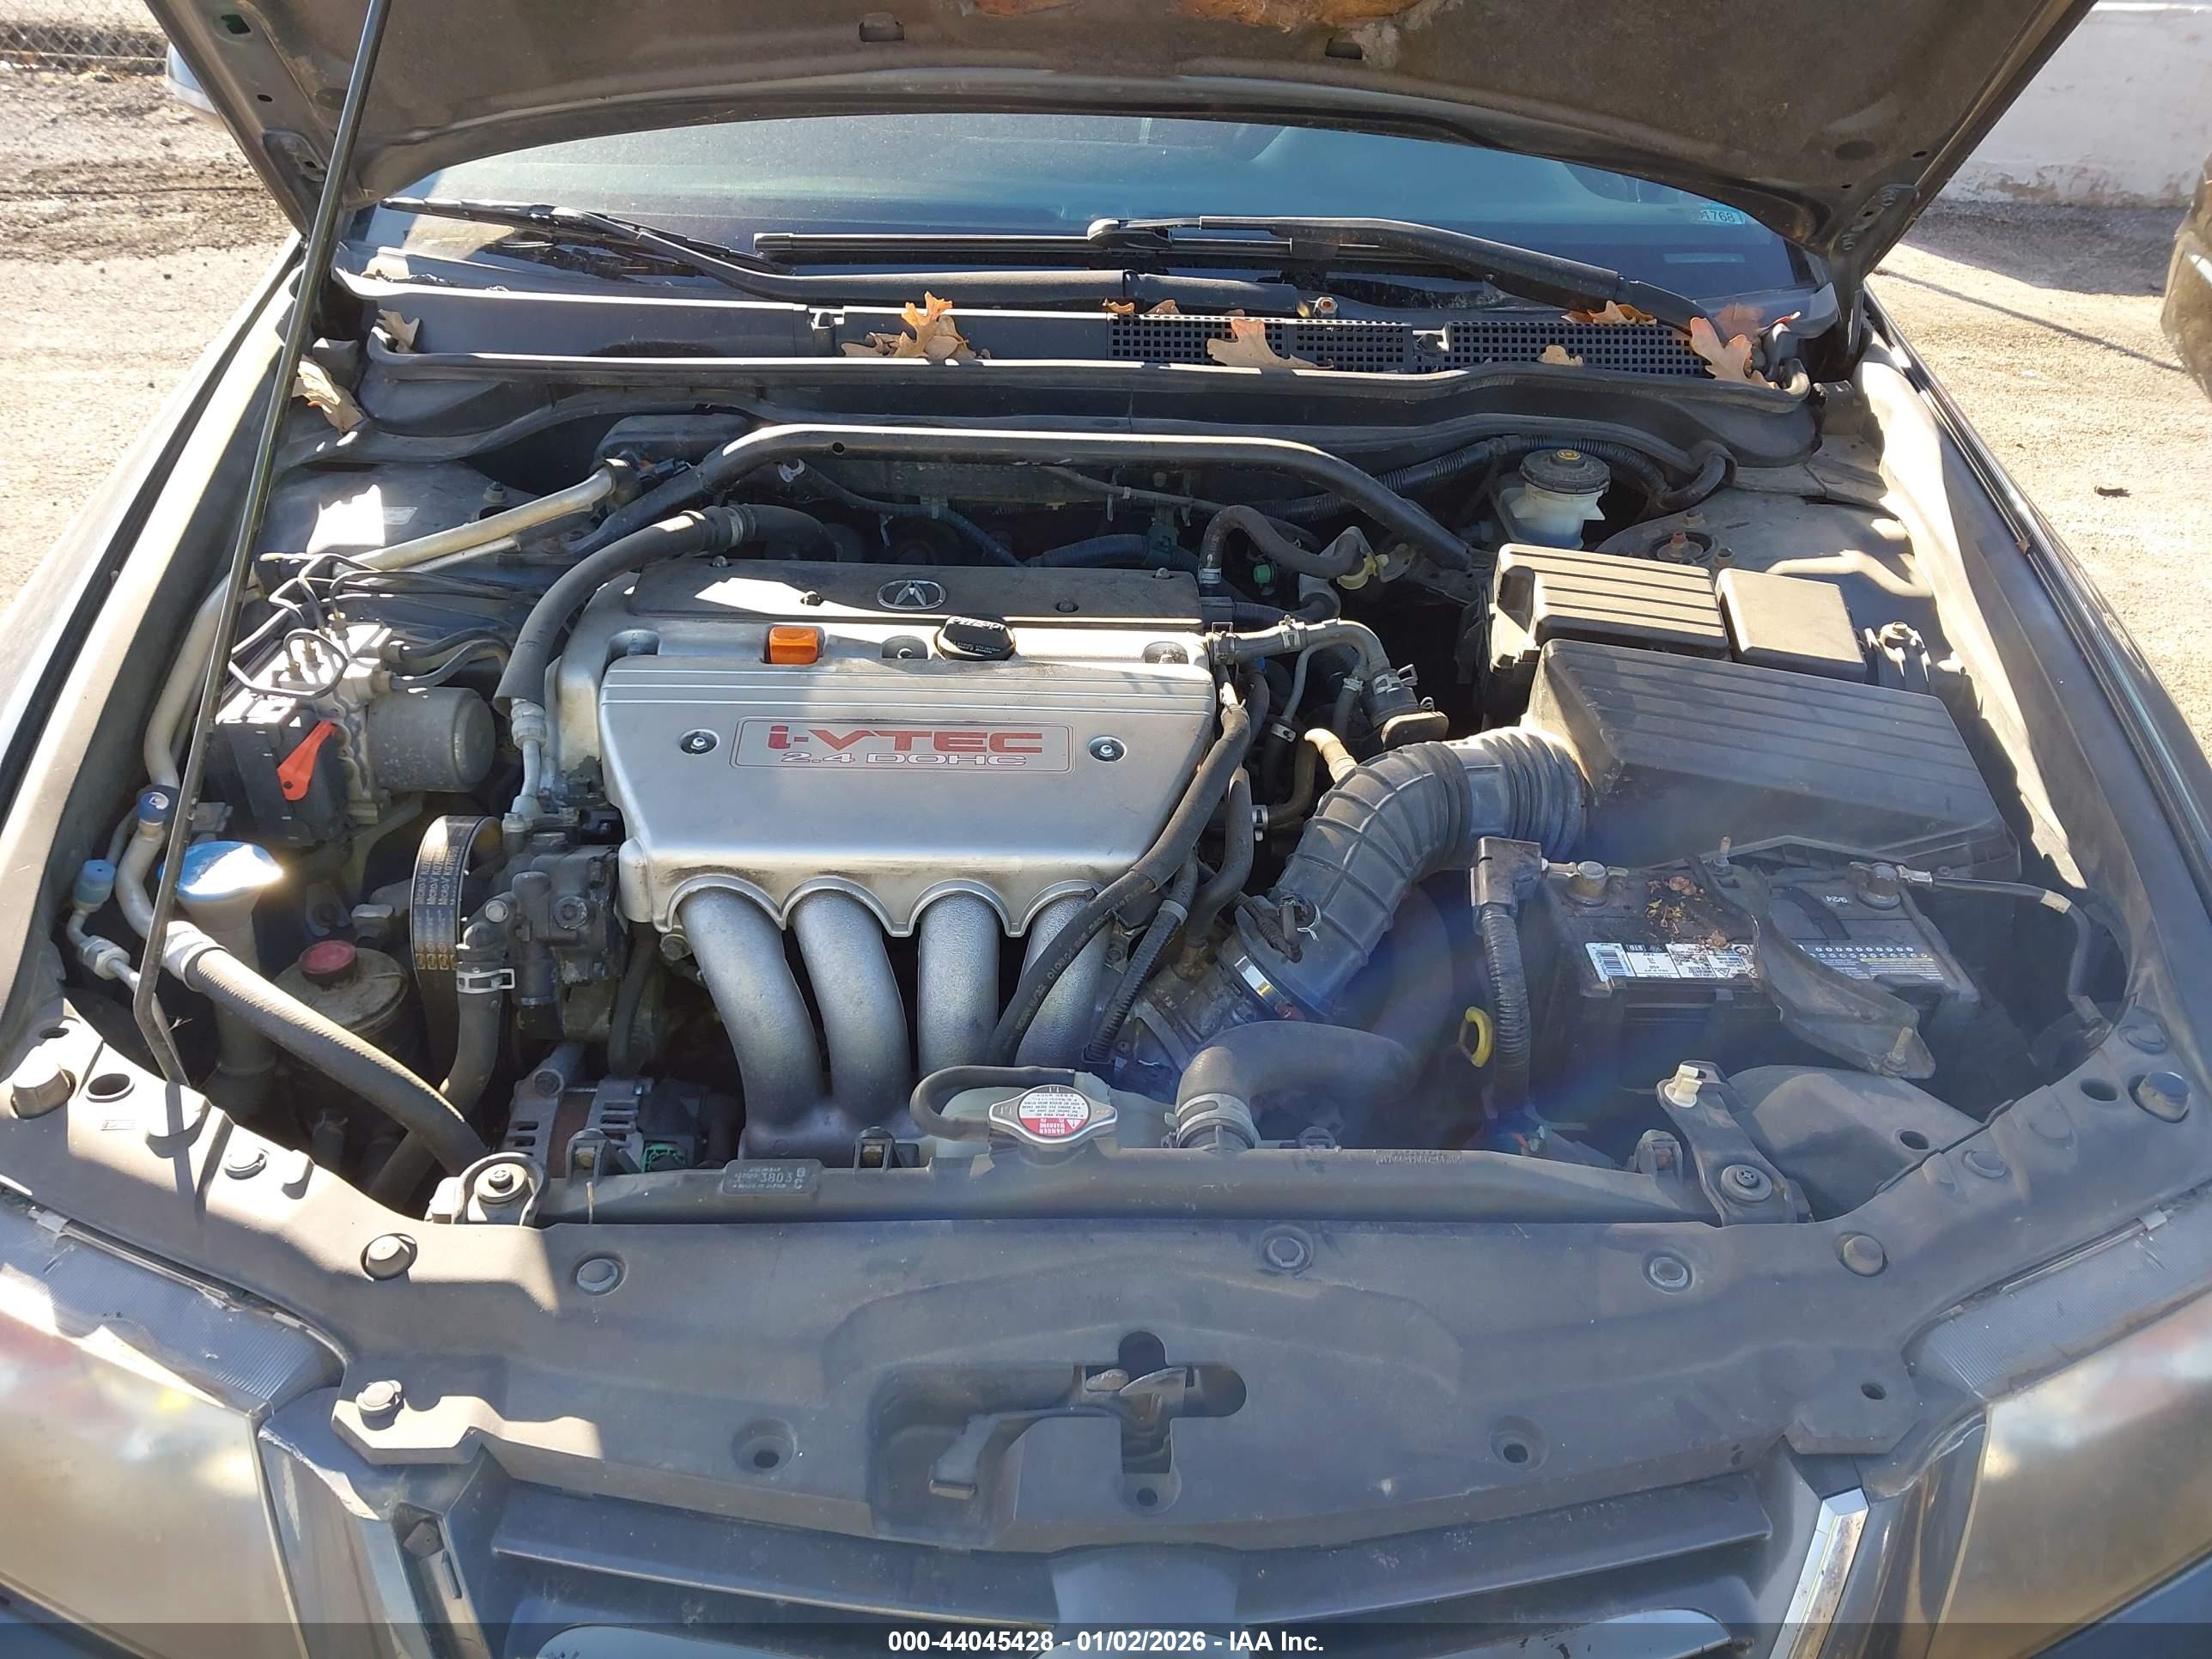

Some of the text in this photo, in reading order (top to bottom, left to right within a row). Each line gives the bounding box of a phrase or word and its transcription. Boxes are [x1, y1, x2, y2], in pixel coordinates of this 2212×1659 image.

[768, 725, 1042, 754] i-VTEC
[781, 751, 1027, 766] 2.4 DOHC
